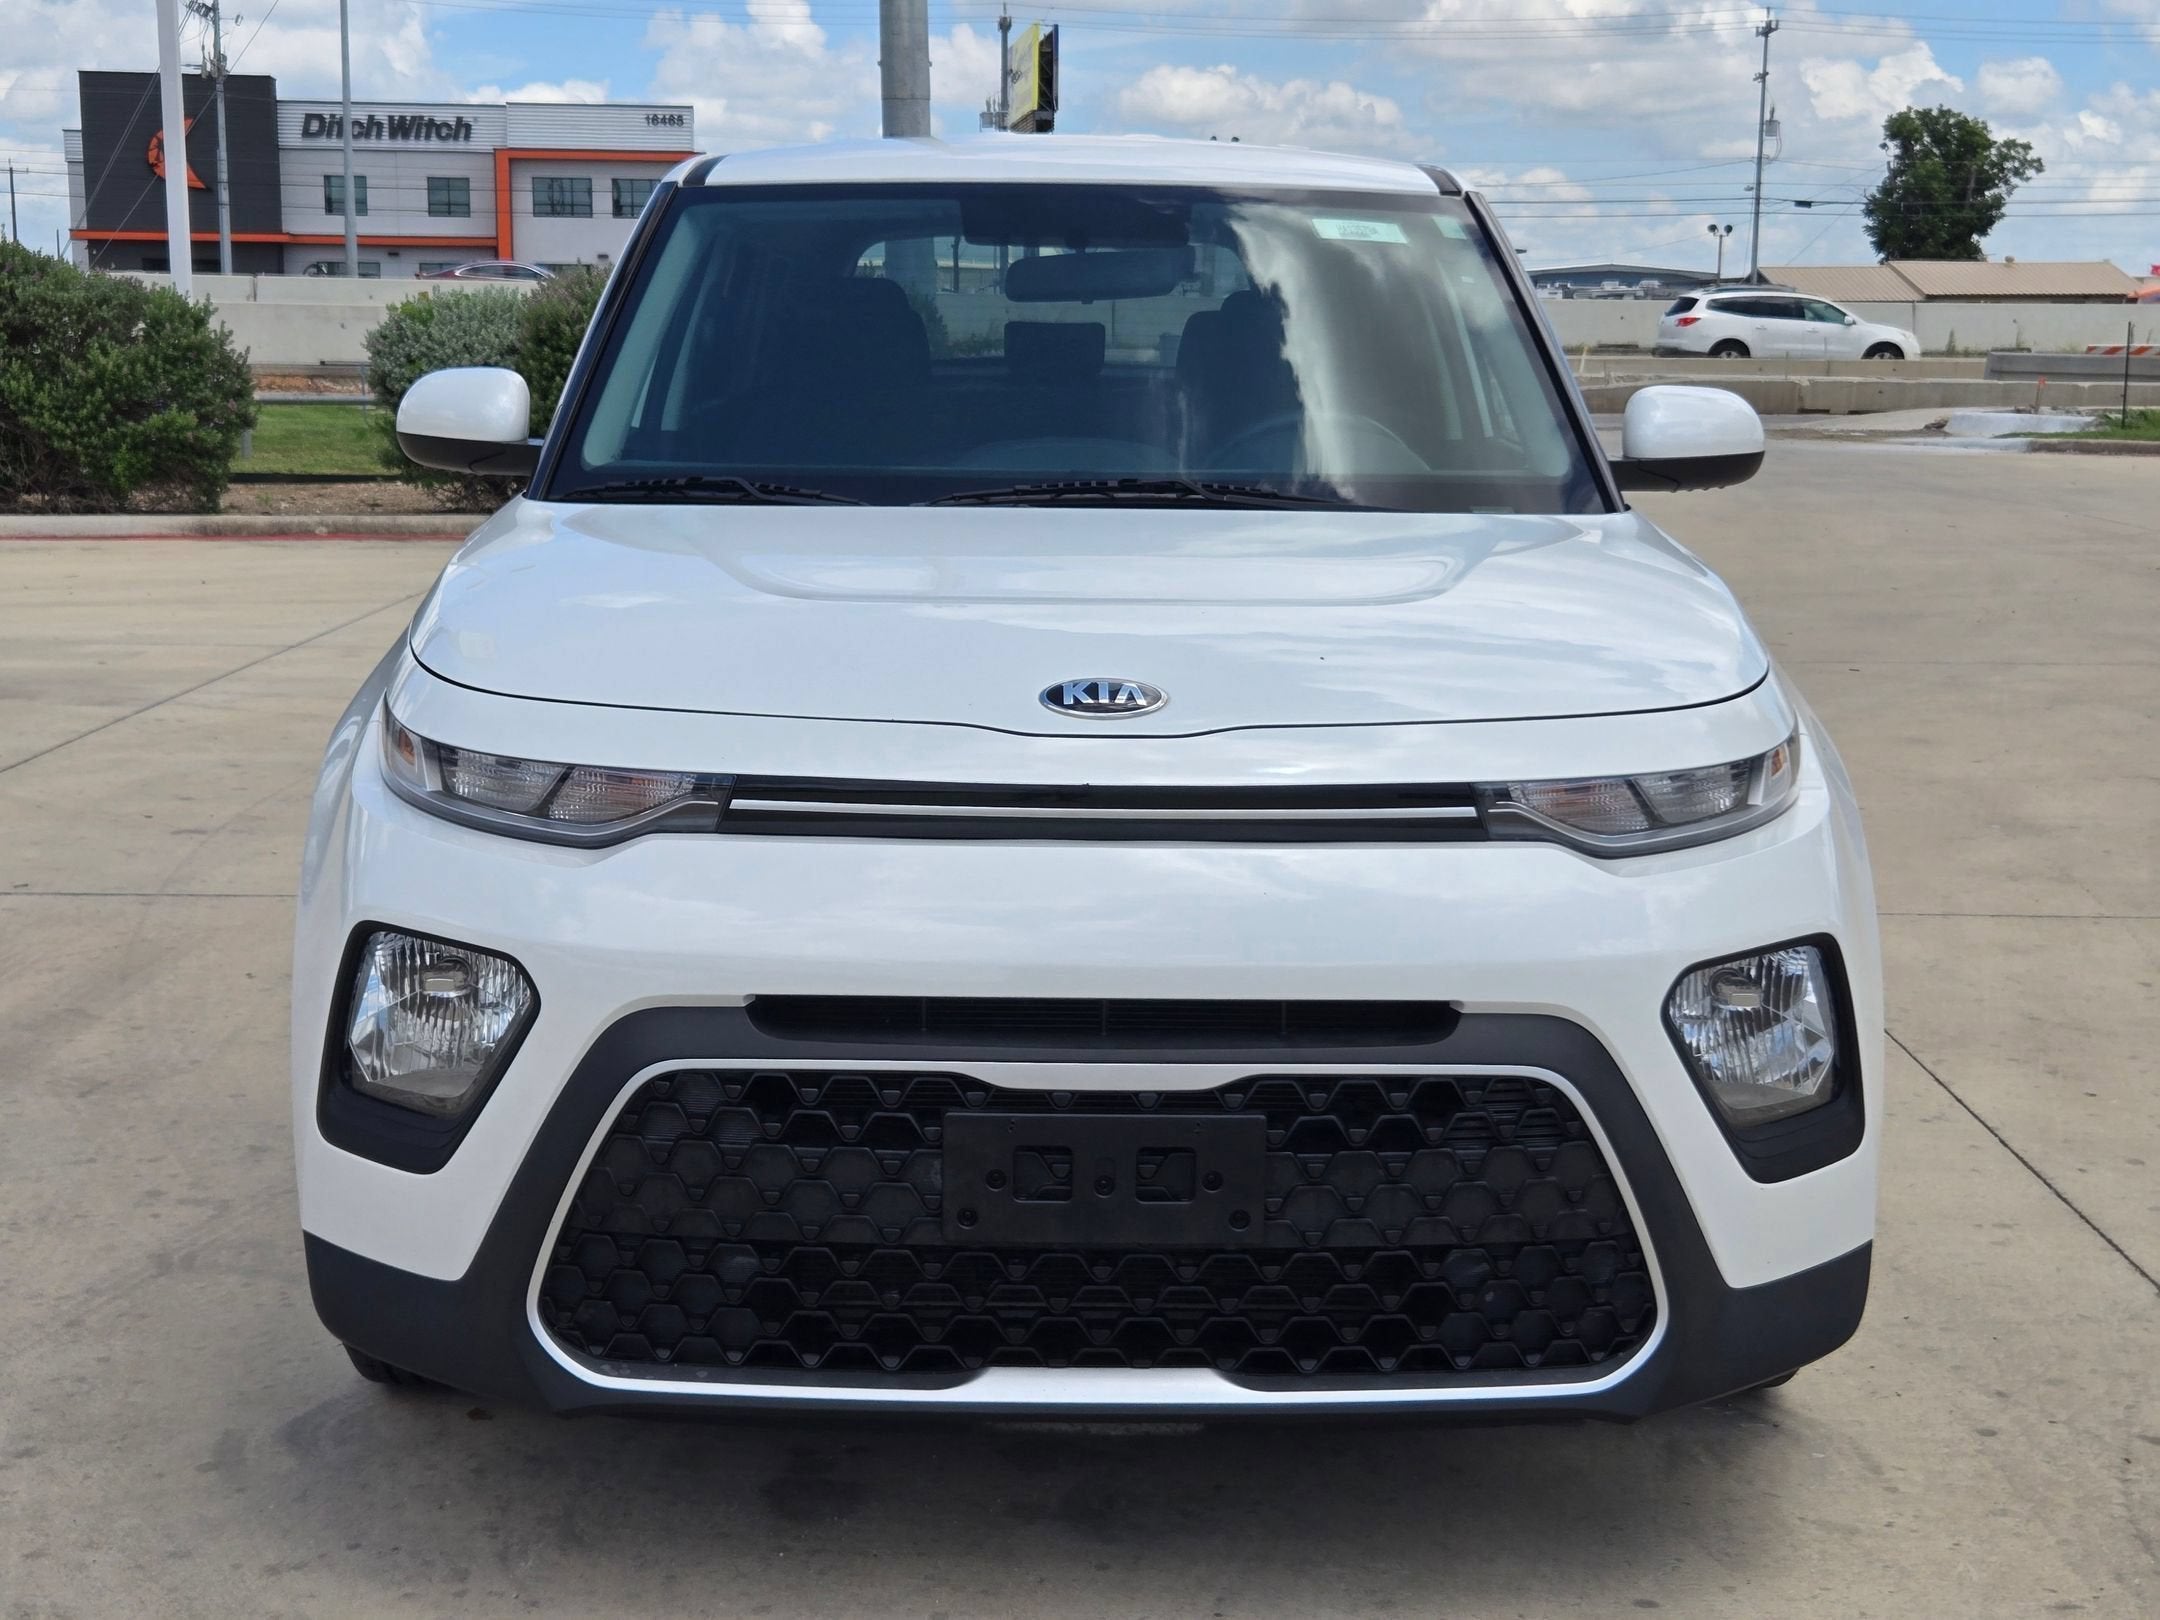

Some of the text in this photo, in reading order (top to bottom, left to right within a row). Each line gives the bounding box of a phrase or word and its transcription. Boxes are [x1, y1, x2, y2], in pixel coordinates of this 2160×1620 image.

[302, 113, 473, 142] Ditch Witch
[1061, 681, 1148, 706] KIA
